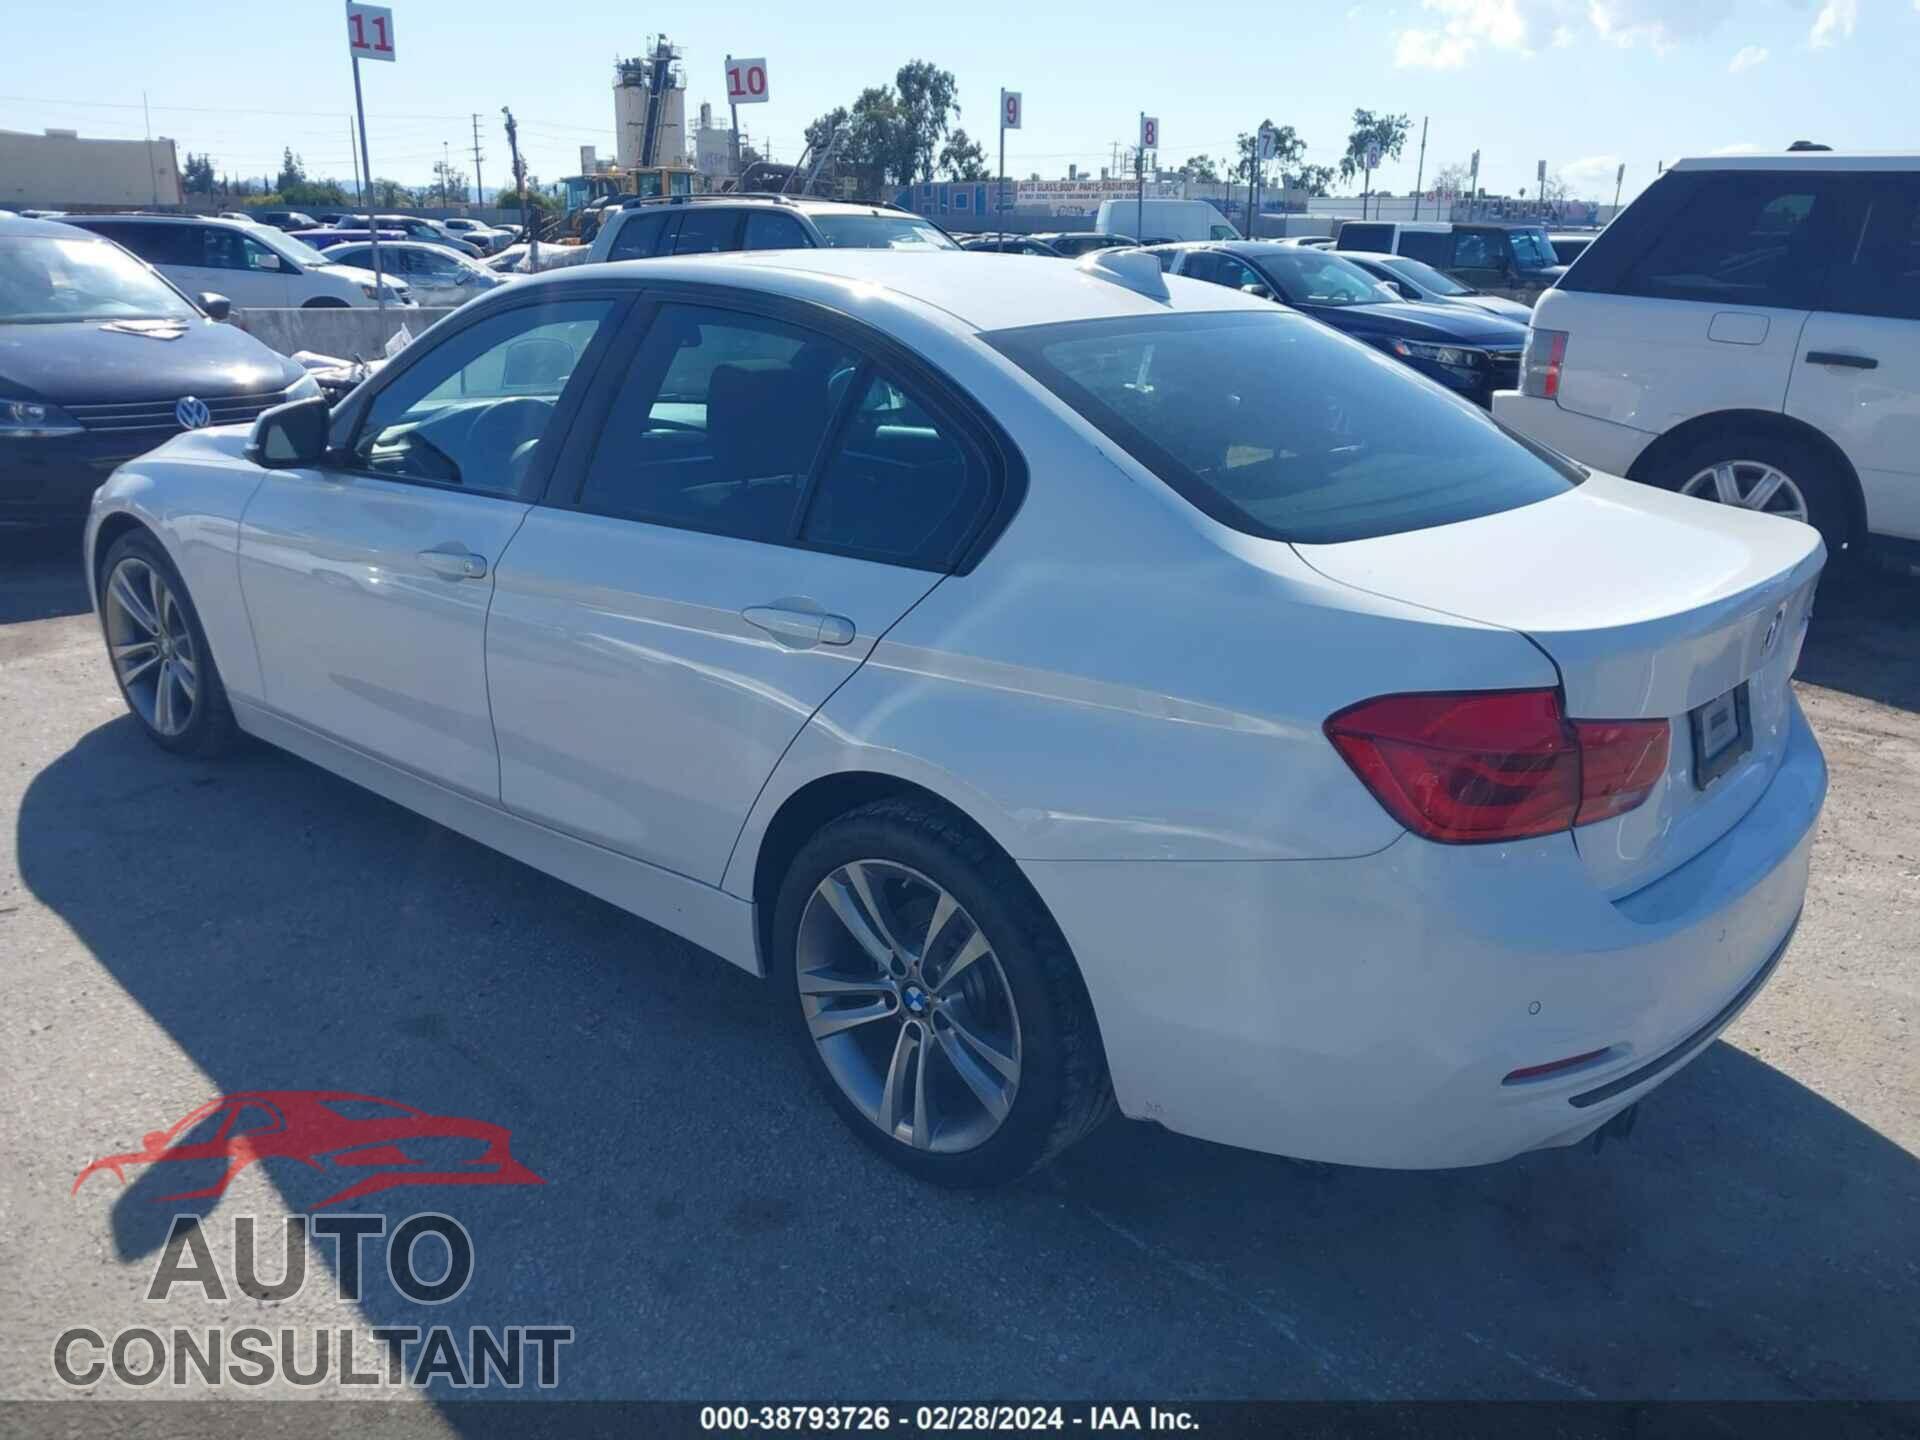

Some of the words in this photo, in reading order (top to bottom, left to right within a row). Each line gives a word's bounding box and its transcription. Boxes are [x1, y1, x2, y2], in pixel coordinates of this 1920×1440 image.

[350, 14, 392, 51] 11
[728, 66, 766, 96] 10
[1007, 97, 1017, 124] 9
[1145, 121, 1154, 145] 8
[1263, 134, 1271, 156] 7
[1018, 182, 1036, 192] AUTO
